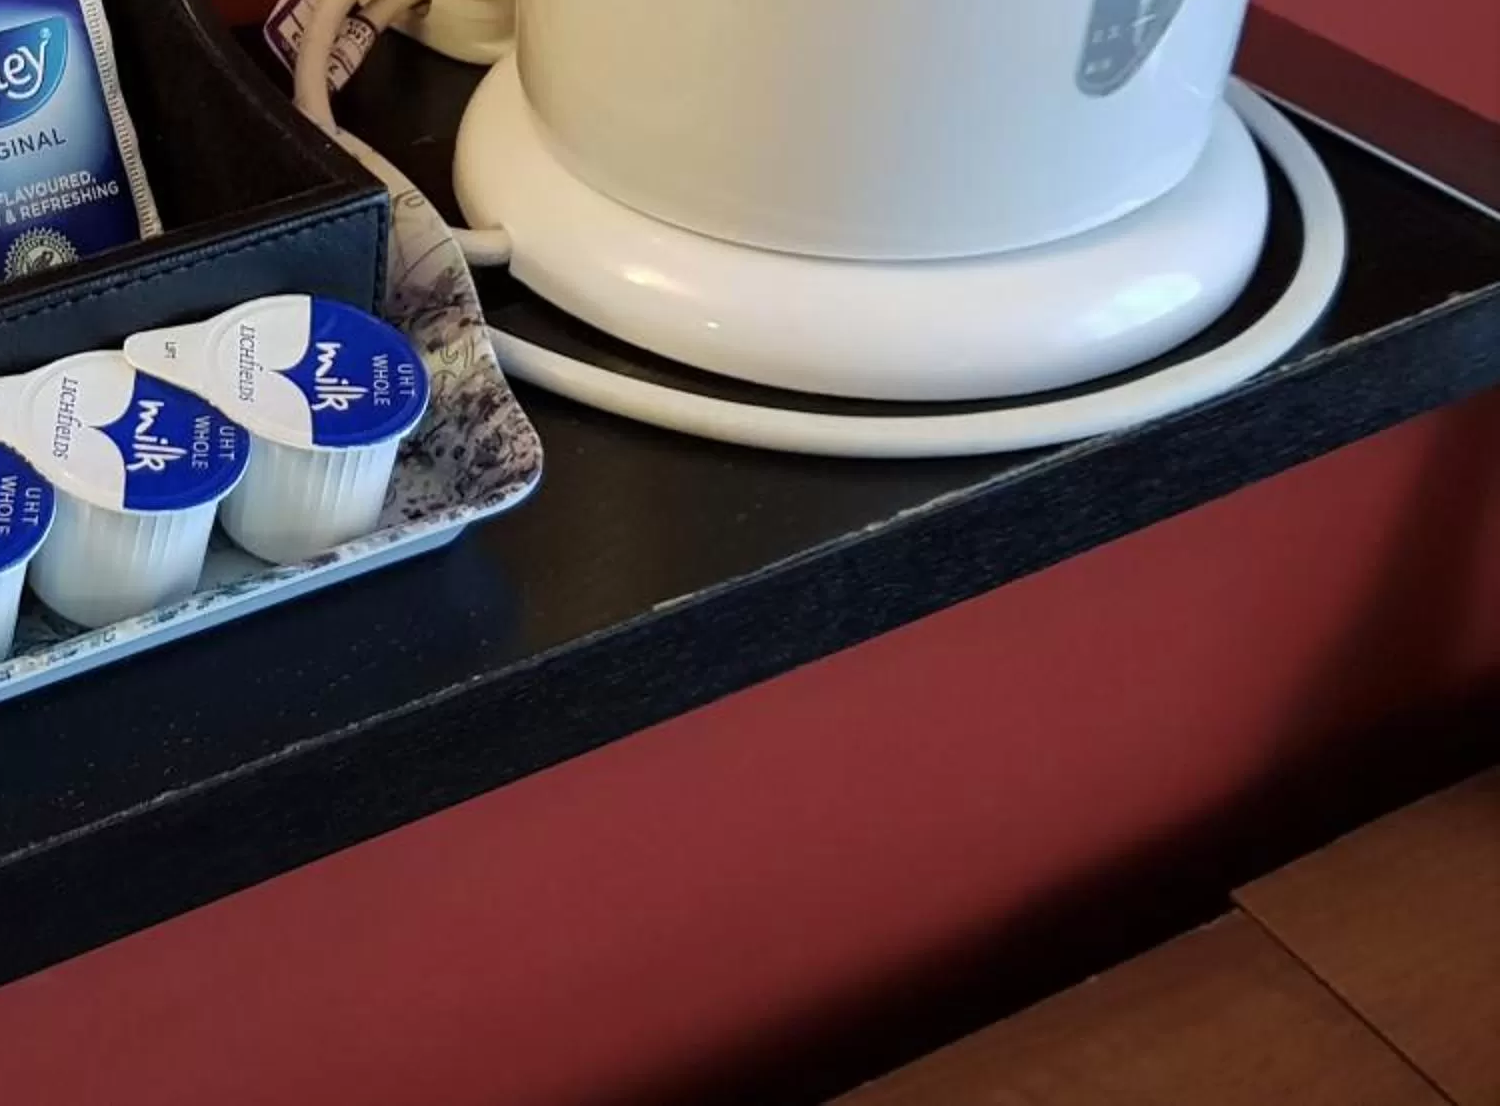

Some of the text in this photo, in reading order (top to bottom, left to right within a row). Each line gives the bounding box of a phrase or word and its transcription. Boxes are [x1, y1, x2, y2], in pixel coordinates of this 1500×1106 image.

[5, 210, 17, 225] &
[19, 181, 119, 220] REFRESHING
[370, 353, 391, 407] WHOLE
[396, 363, 416, 399] UHT
[191, 414, 213, 471] WHOLE
[218, 424, 236, 462] UHT
[22, 486, 42, 528] UHT
